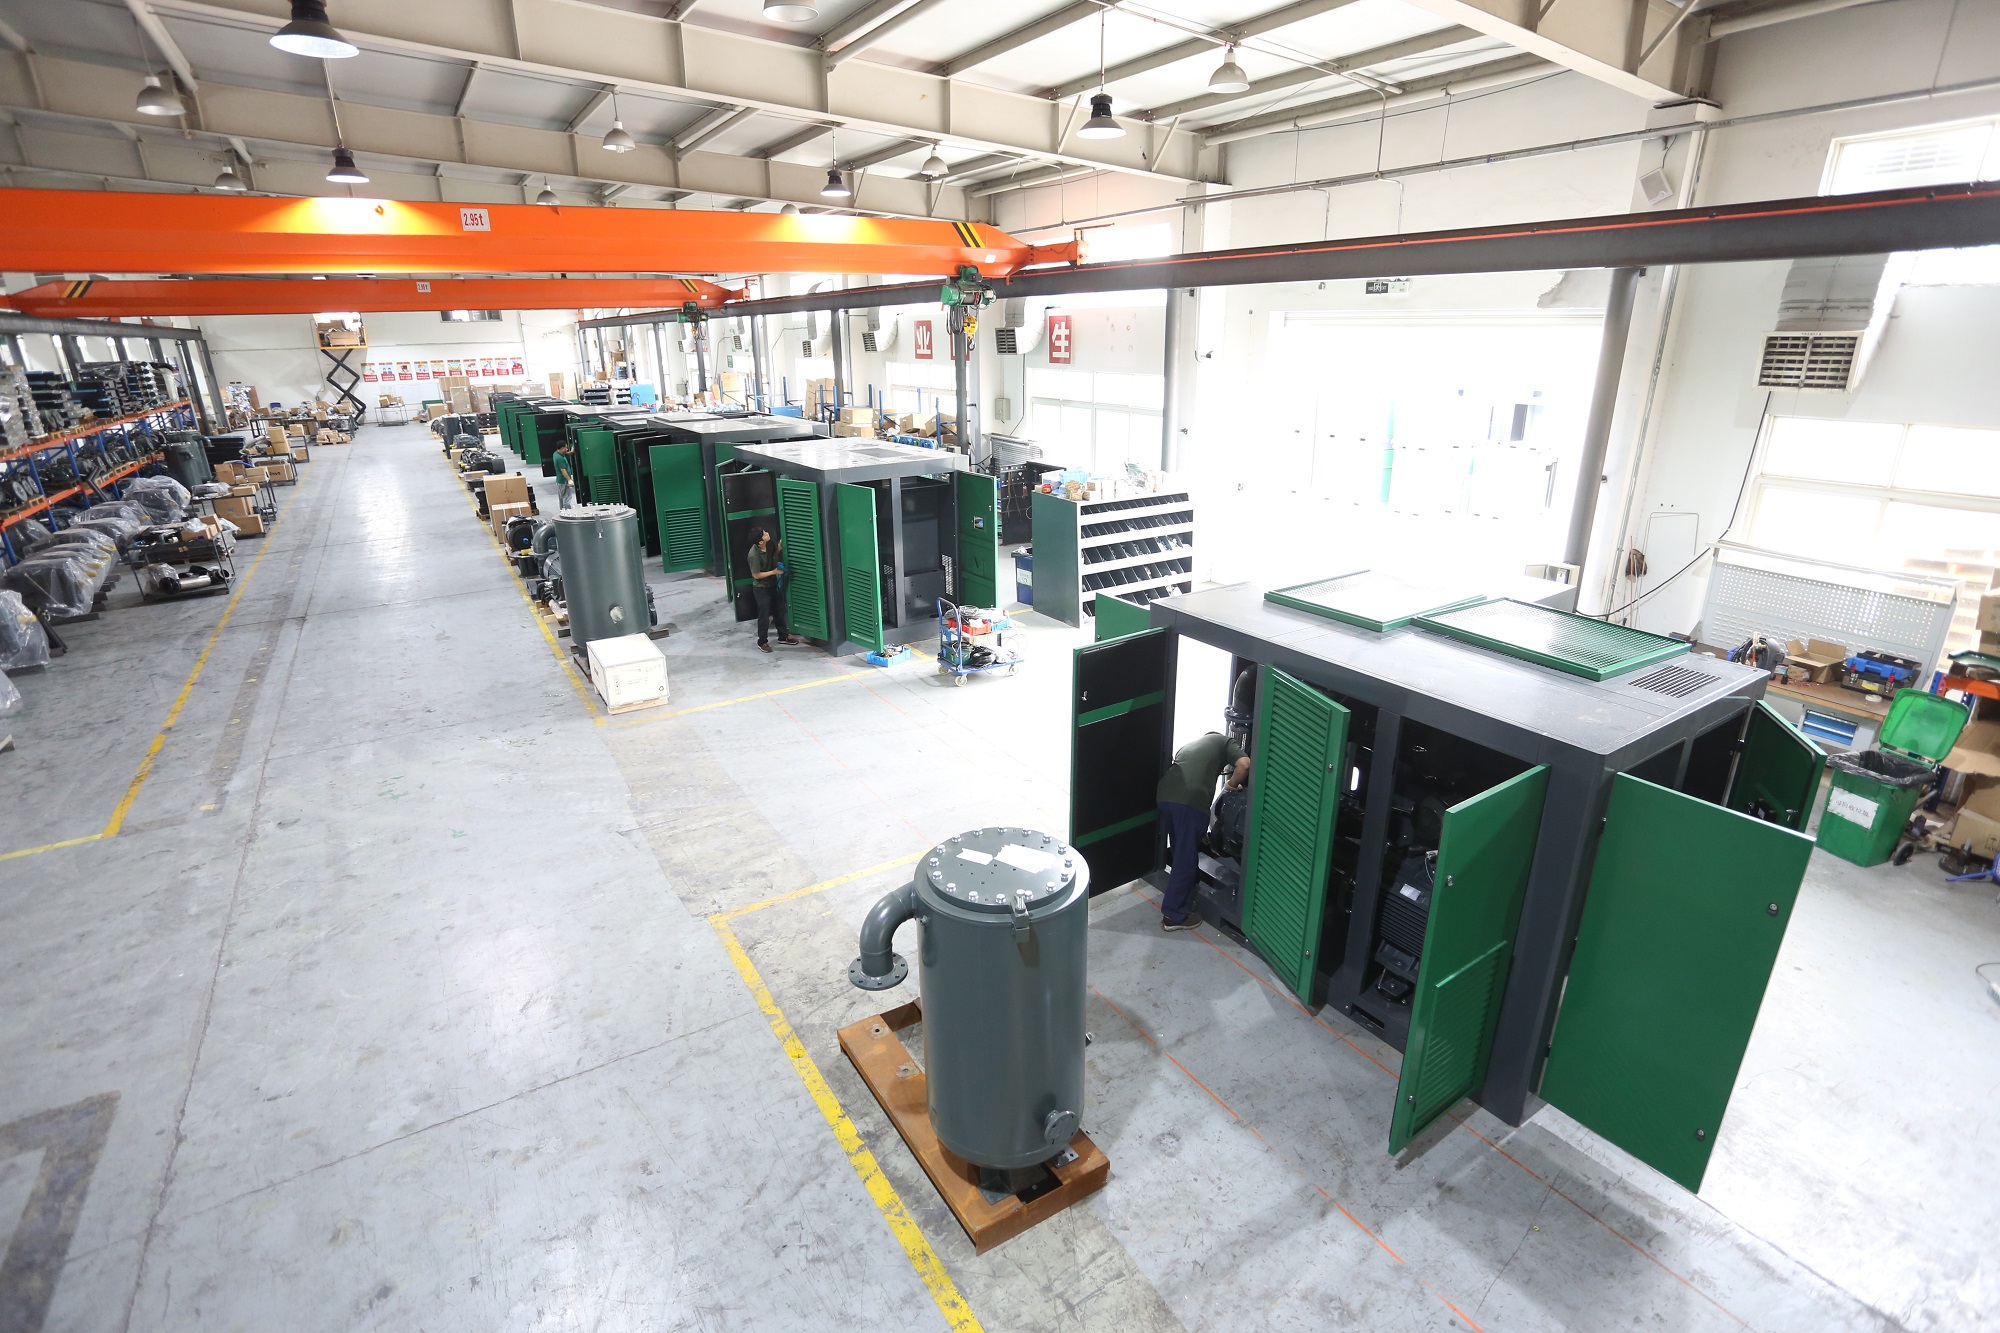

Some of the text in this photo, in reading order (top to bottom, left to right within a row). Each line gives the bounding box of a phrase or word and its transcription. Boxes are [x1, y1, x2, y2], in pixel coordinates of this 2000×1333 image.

[463, 213, 484, 226] 2.95t
[916, 325, 931, 354] 业
[1051, 321, 1070, 358] 生
